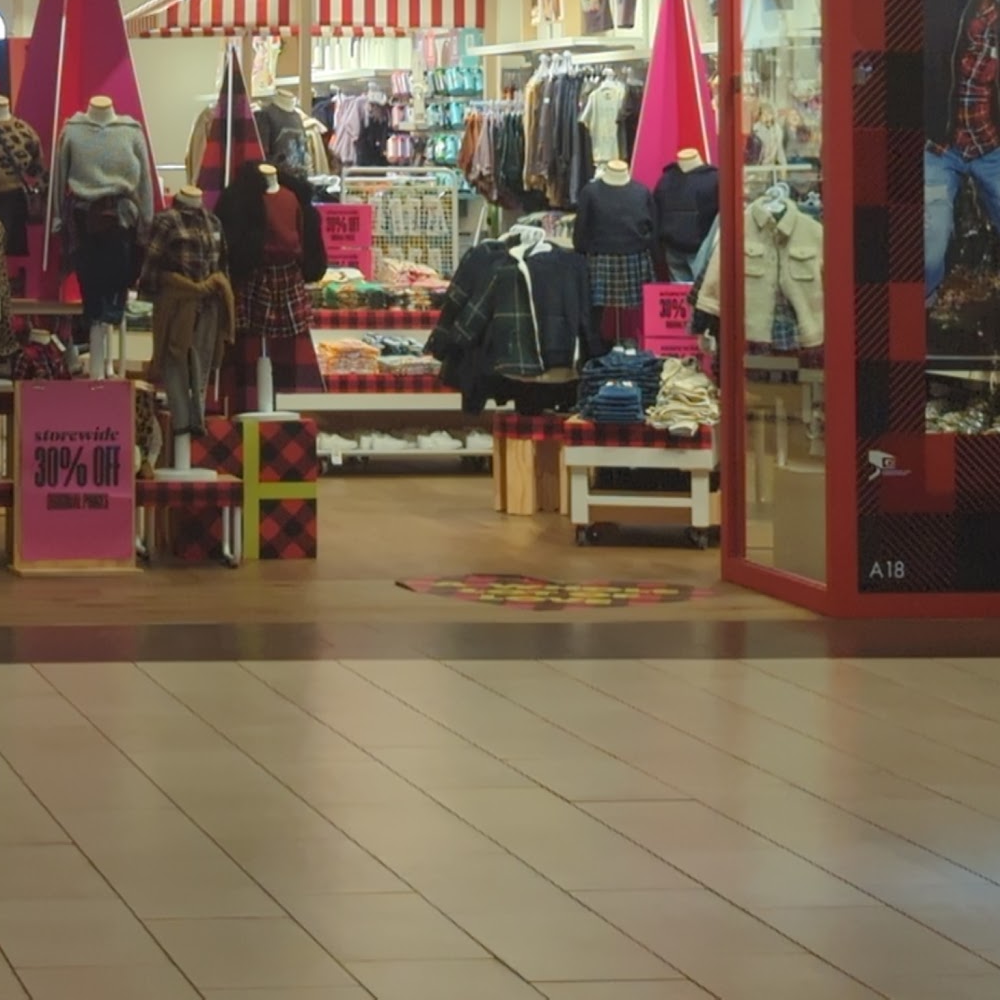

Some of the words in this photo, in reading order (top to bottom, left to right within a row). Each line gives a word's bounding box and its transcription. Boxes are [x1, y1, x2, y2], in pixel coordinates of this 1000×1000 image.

[34, 427, 119, 442] storewide
[34, 446, 87, 487] 30%
[93, 446, 121, 487] OFF
[869, 560, 905, 579] A18
